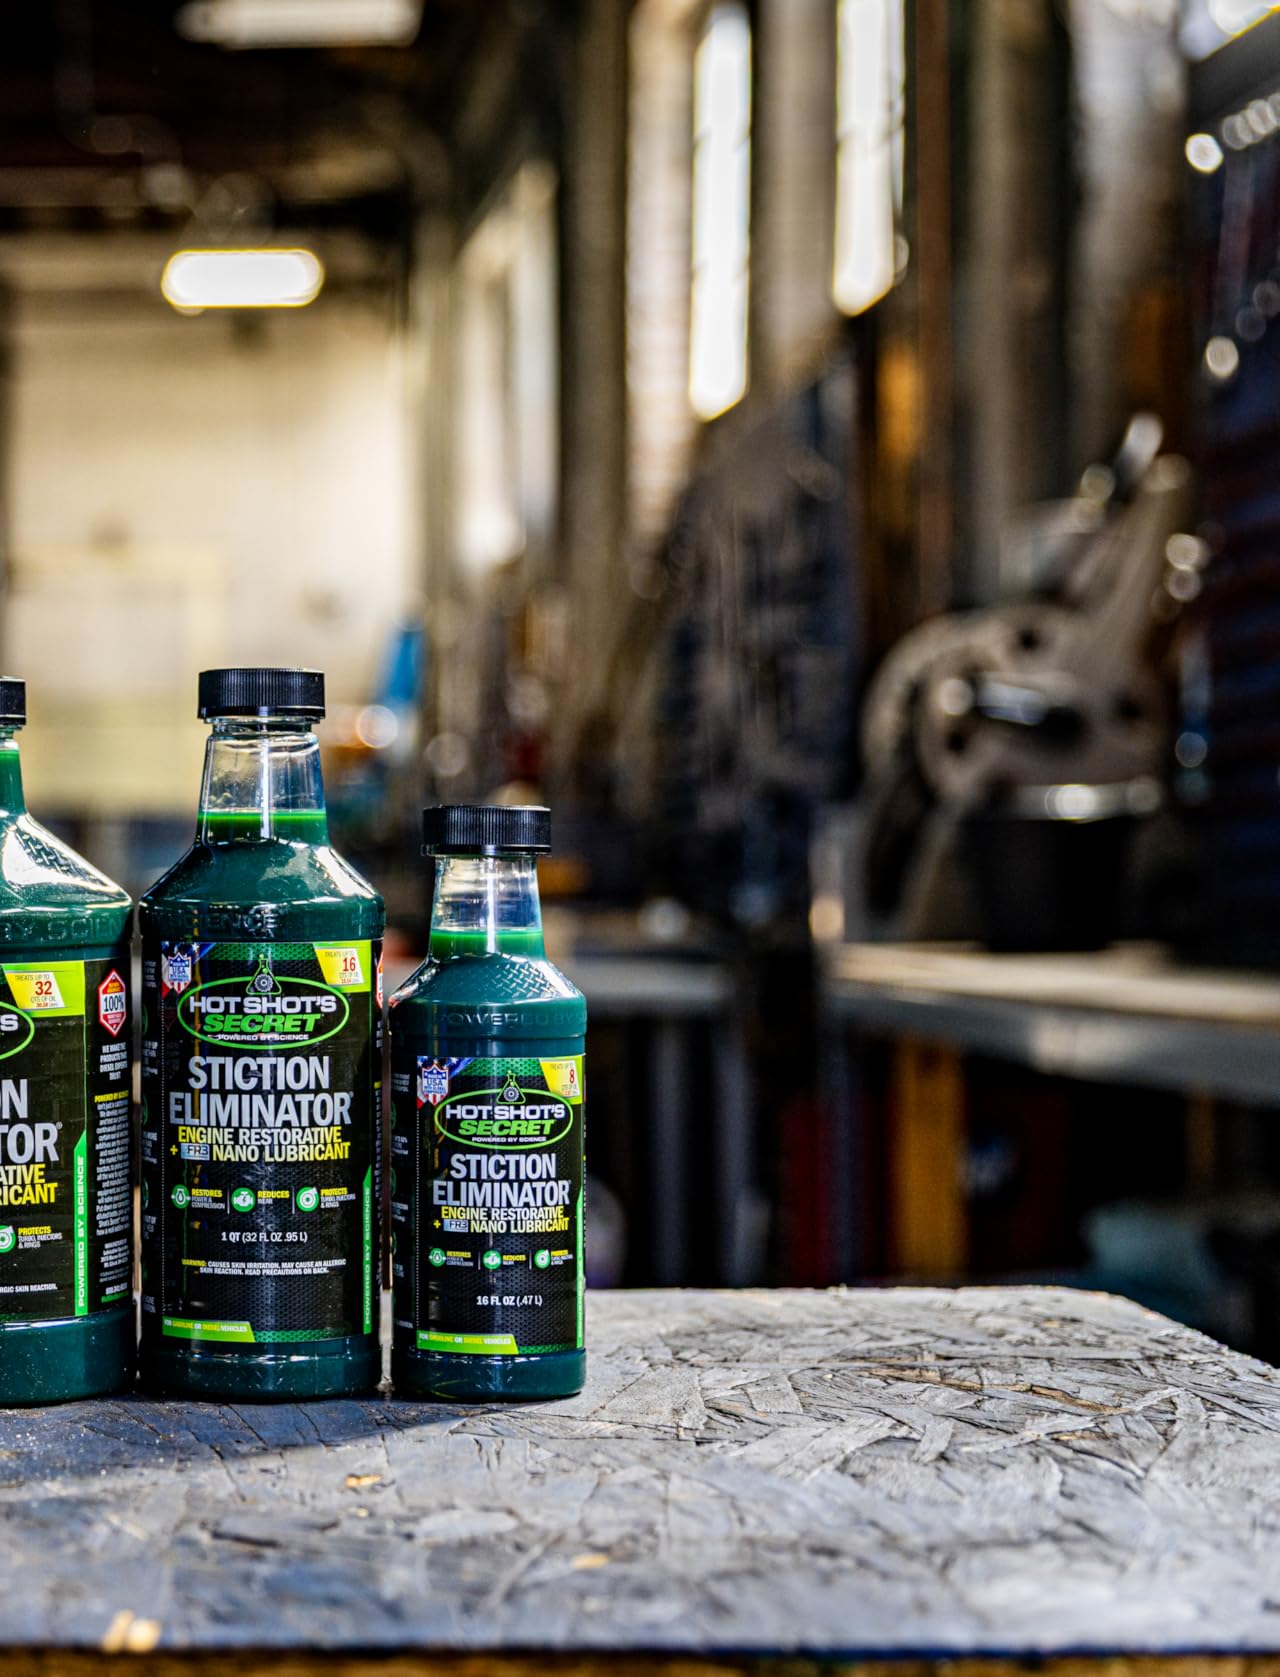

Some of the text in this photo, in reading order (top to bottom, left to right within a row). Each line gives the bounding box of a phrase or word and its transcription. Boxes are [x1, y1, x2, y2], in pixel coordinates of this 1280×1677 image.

[173, 966, 186, 974] USA
[343, 957, 356, 971] 16
[35, 980, 53, 996] 32
[103, 994, 125, 1012] 100%
[189, 995, 337, 1013] HOT SHOT'S
[204, 1013, 321, 1033] SECRET
[188, 1055, 330, 1091] STICTION
[569, 1069, 575, 1083] 8
[427, 1078, 443, 1086] USA
[445, 1103, 565, 1120] HOT SHOT'S
[458, 1119, 556, 1135] SECRET
[178, 1126, 343, 1146] ENGINE RESTORATIVE
[212, 1143, 260, 1162] NANO
[264, 1141, 351, 1162] LUBRICANT
[450, 1153, 556, 1180] STICTION
[191, 1188, 223, 1198] RESTORES
[257, 1190, 290, 1199] REDUCES
[321, 1187, 348, 1197] PROTECTS
[441, 1206, 564, 1220] ENGINE RESTORATIVE
[18, 1226, 52, 1236] PROTECTS
[78, 1219, 84, 1238] BY
[470, 1220, 507, 1233] NANO
[510, 1217, 569, 1233] LUBRICANT
[221, 1230, 308, 1244] 1 QT (32 FL OZ .95 L)
[502, 1254, 526, 1262] REDUCES
[476, 1294, 543, 1307] 16 FL OZ (.47 L)
